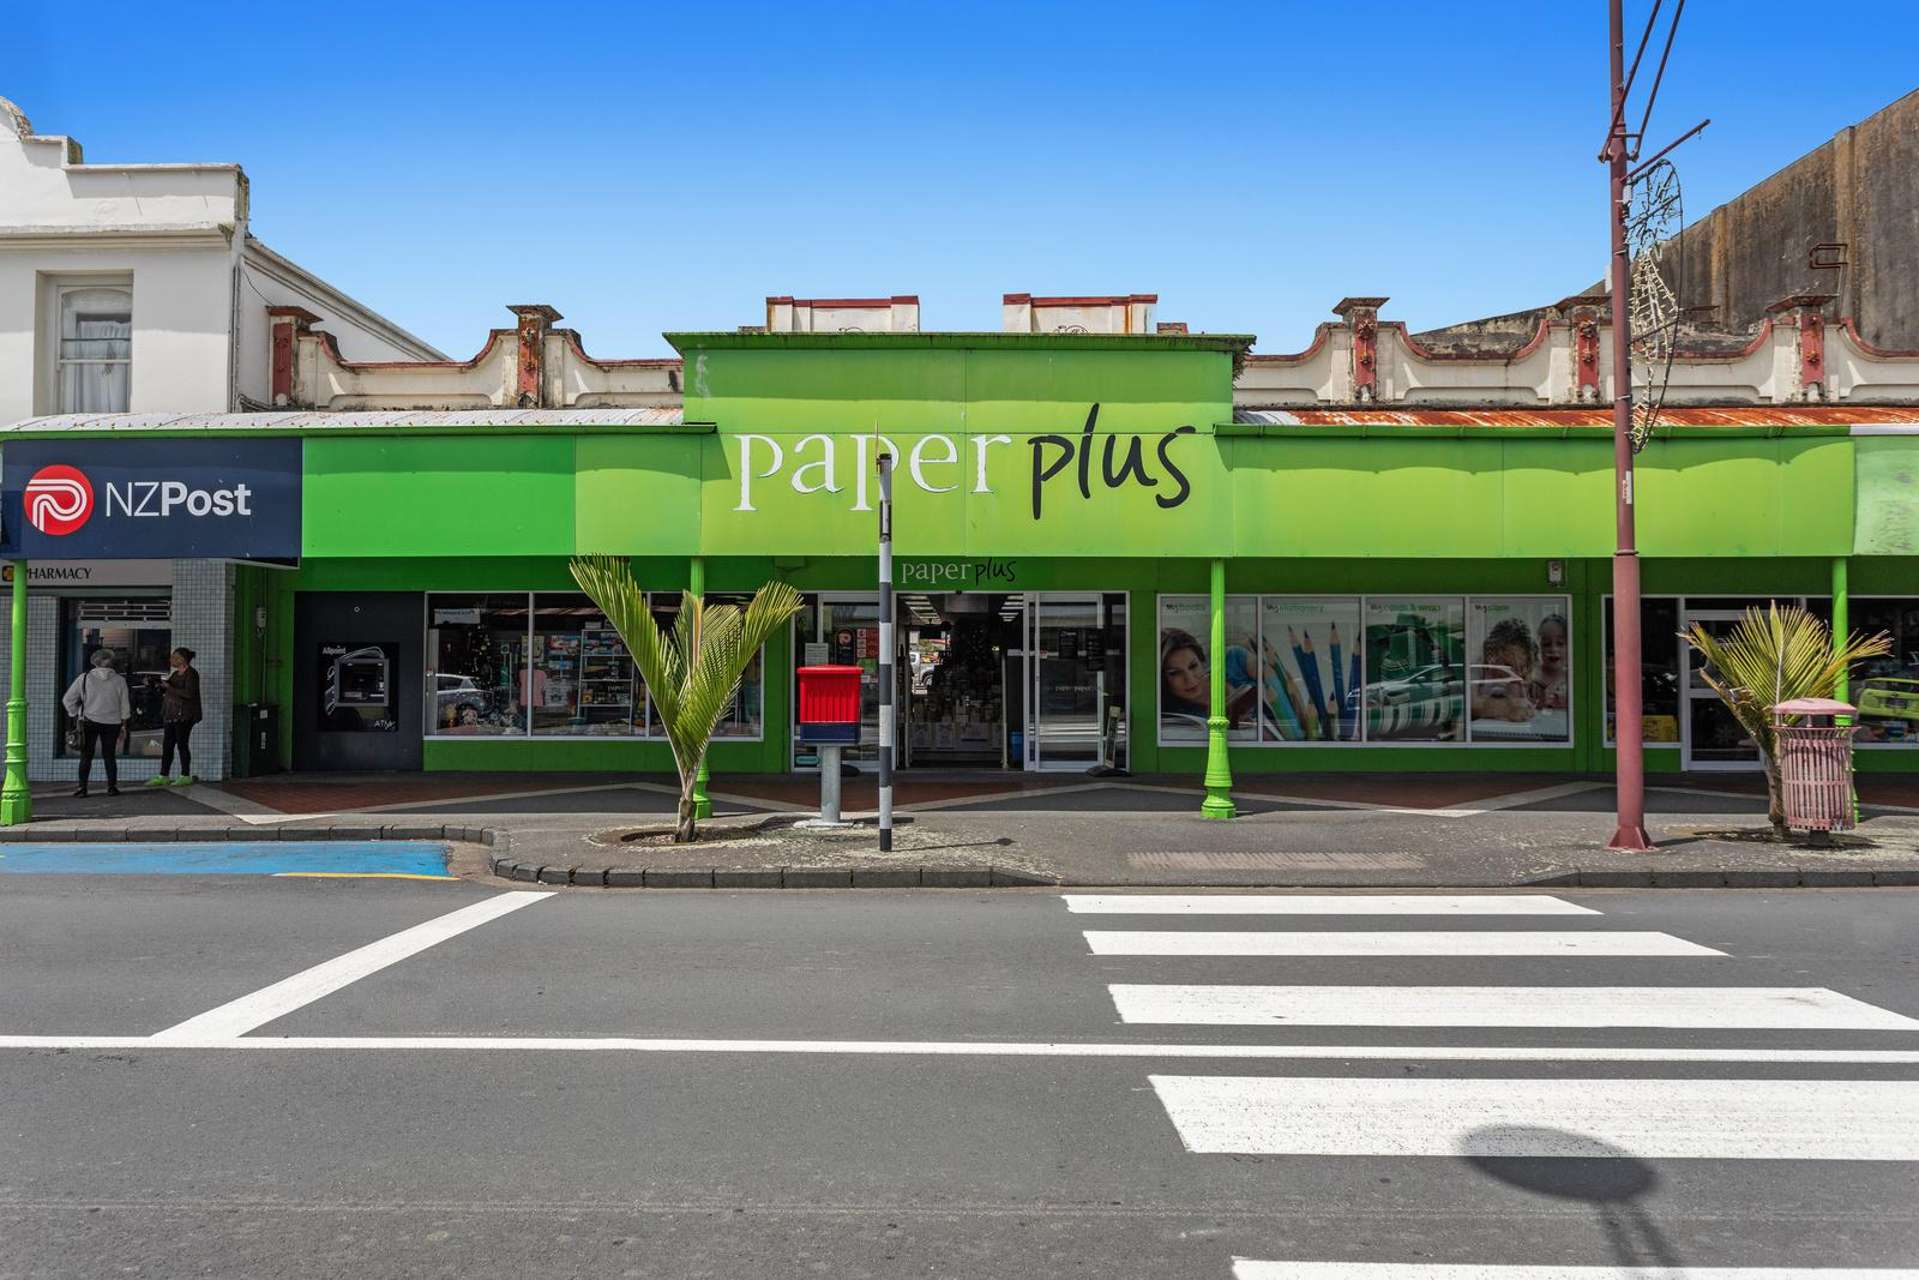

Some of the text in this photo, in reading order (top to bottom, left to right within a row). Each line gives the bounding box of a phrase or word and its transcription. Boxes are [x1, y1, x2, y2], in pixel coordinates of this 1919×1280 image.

[733, 402, 1197, 520] paper plus
[105, 481, 252, 517] NZPost
[26, 567, 92, 579] HARMACY
[901, 558, 1017, 586] paper plus
